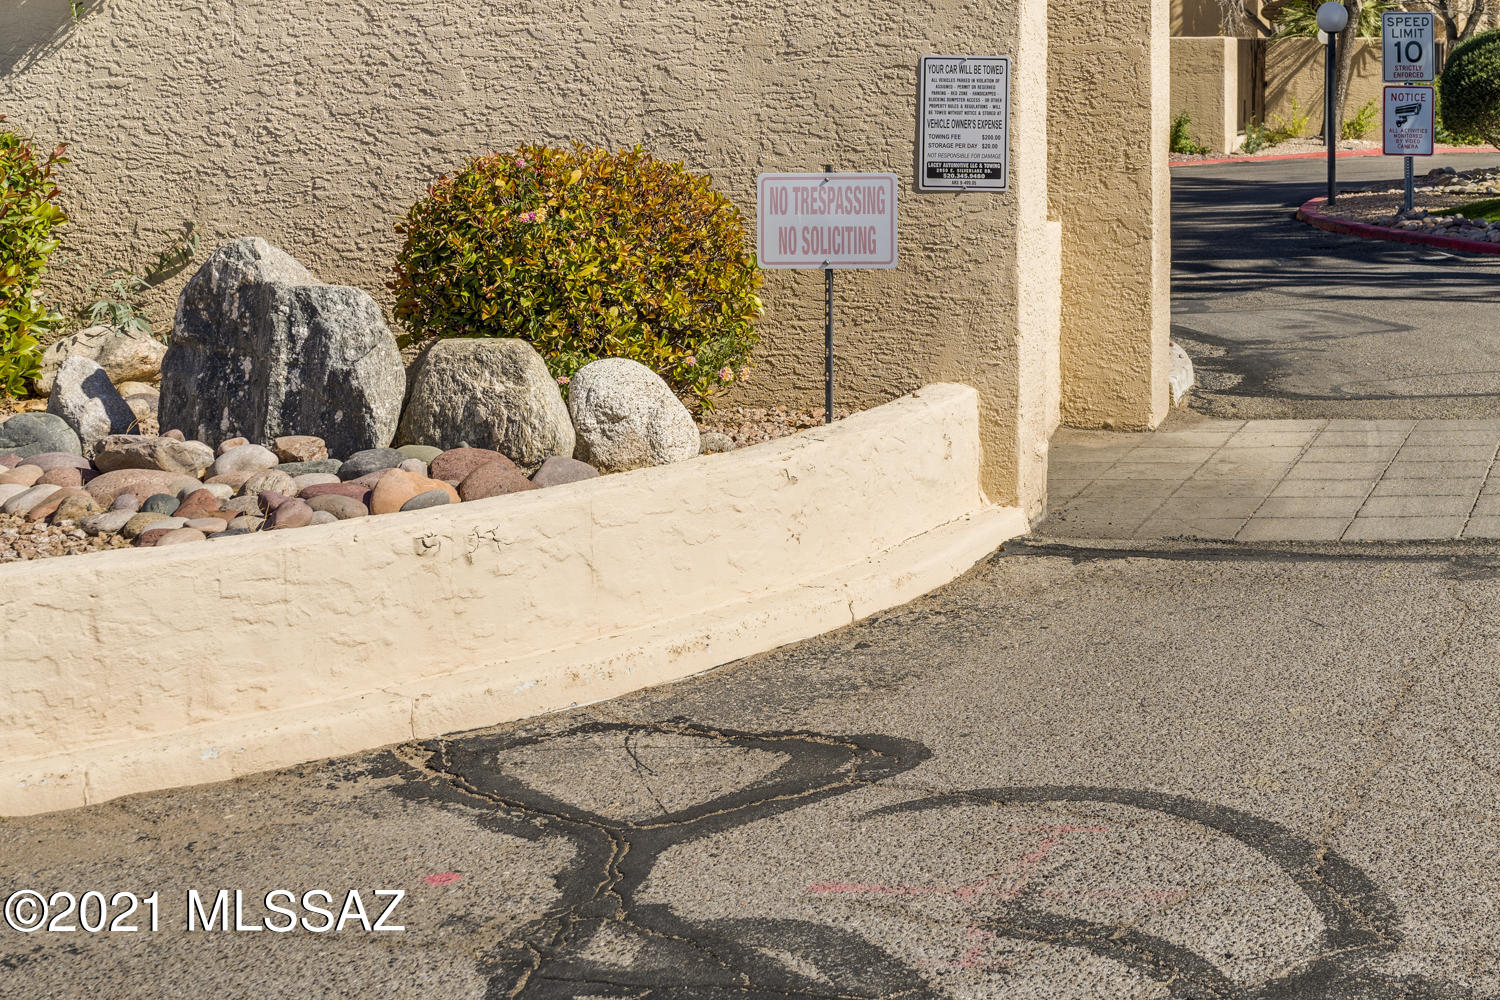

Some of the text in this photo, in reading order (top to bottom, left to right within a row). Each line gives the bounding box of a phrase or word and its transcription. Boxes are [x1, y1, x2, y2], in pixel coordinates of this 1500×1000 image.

[1387, 17, 1429, 27] SPEED
[1392, 29, 1424, 38] LIMIT
[1394, 41, 1422, 63] 10
[928, 64, 1003, 74] YOUR CAR WILL BE TOWED
[1391, 93, 1426, 102] NOTICE
[927, 119, 1002, 129] VEHICLE OWNER'S EXPENSE
[769, 185, 885, 215] NO TRESPASSING
[778, 225, 876, 255] NO SOLICITING
